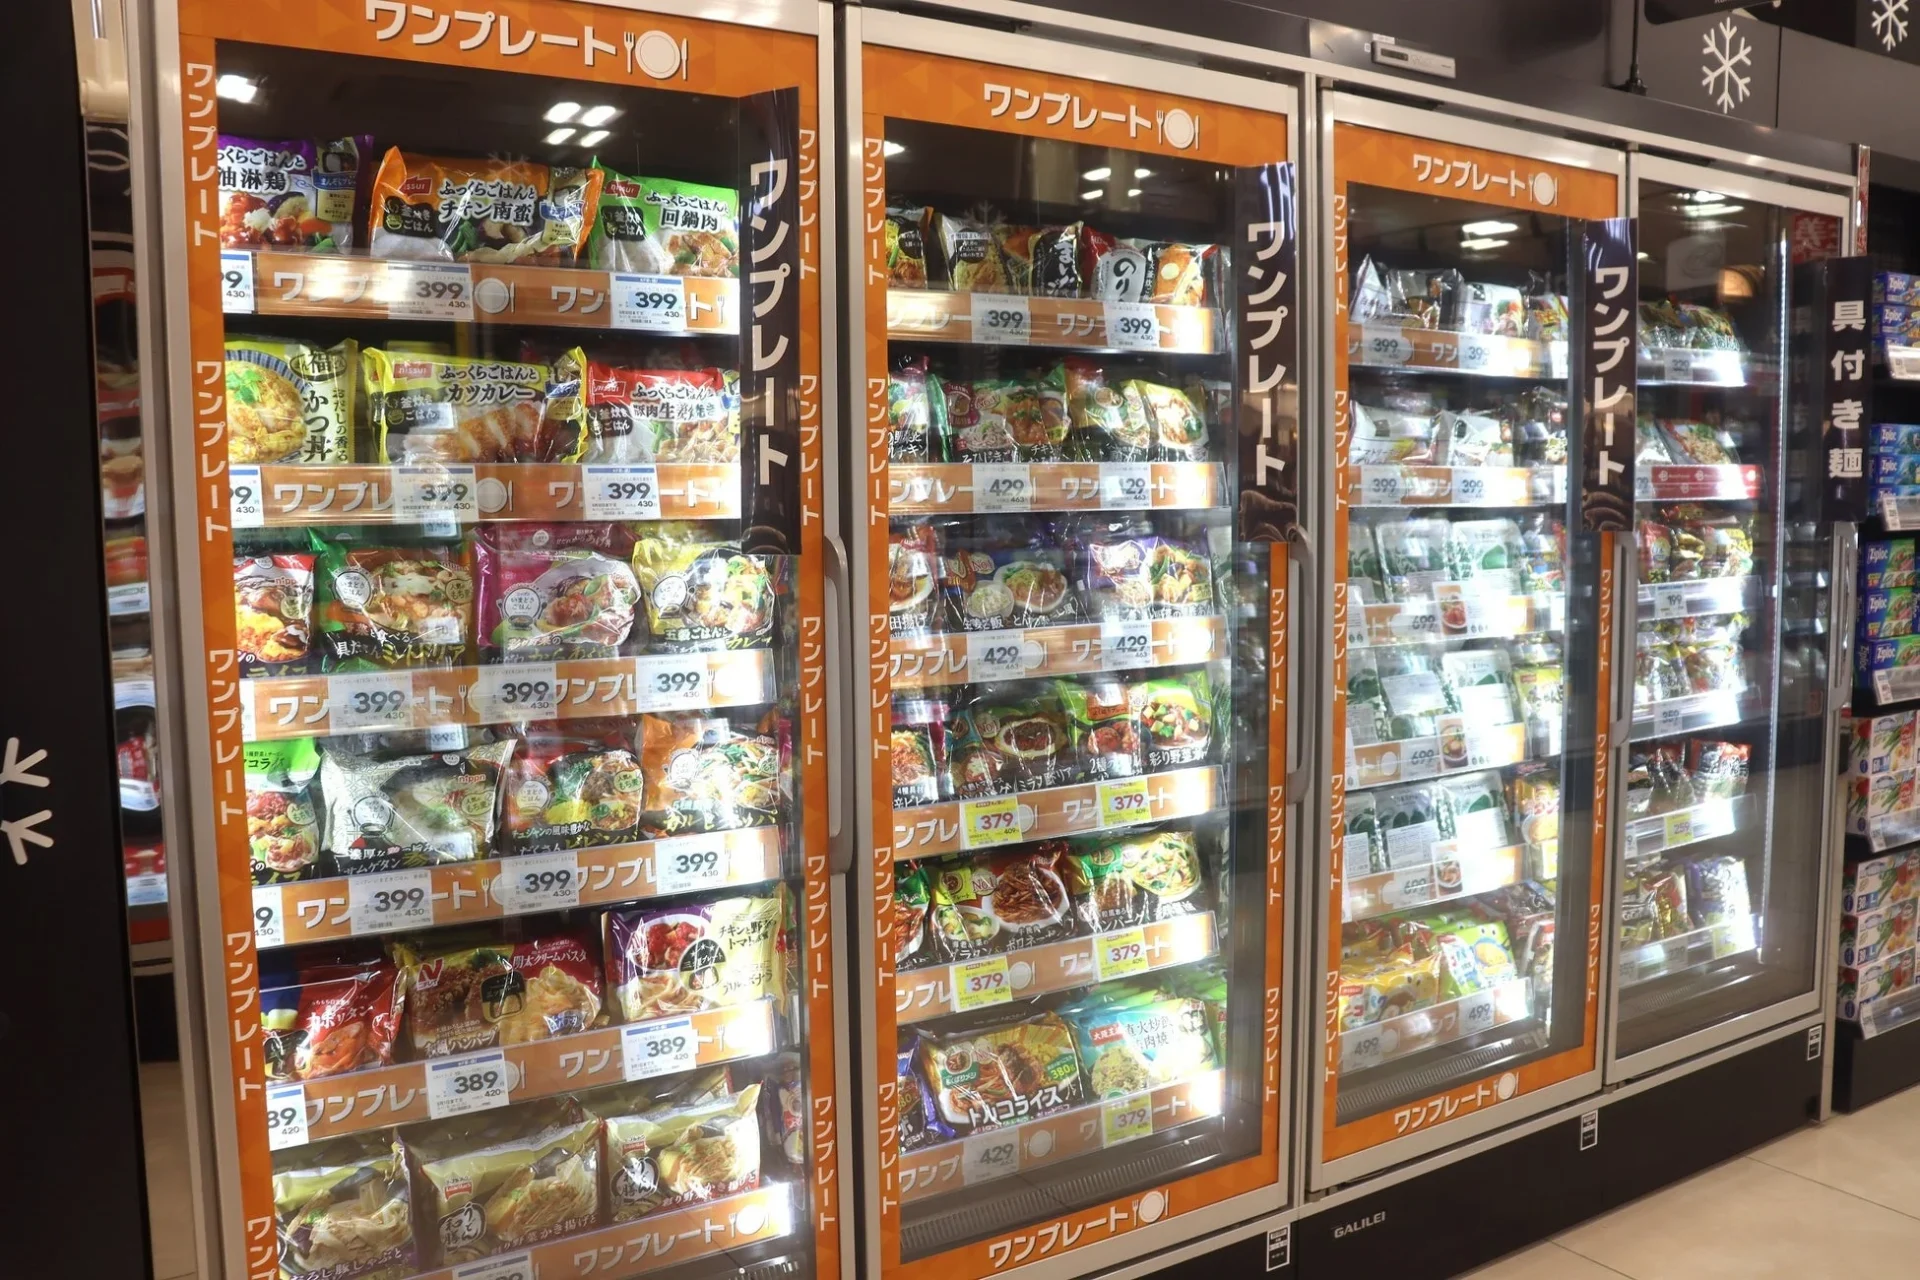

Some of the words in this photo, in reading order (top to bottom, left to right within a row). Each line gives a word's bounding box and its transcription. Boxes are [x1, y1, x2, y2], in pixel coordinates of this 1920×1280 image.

[366, 0, 617, 66] ワンプレート
[983, 82, 1152, 138] ワンプレート
[186, 63, 217, 246] ワンプレート
[1412, 153, 1526, 198] ワンプレート
[799, 129, 817, 279] ワンプレート
[864, 139, 884, 286] ワンプレート
[1334, 194, 1348, 315] ワンプレート
[415, 281, 464, 299] 399
[635, 291, 678, 309] 399
[448, 300, 467, 309] 430
[750, 159, 790, 486] ワンプレート
[988, 310, 1023, 328] 399
[1119, 317, 1152, 334] 399
[1247, 221, 1289, 486] ワンプレート
[1374, 338, 1399, 352] 399
[439, 364, 538, 381] ふっくらごはんと
[1593, 266, 1630, 486] ワンプレート
[448, 383, 536, 402] カツカレー
[1828, 300, 1866, 480] 具付き麺
[302, 390, 333, 463] かつ丼
[197, 361, 229, 541] ワンプレート
[800, 375, 819, 526] ワンプレート
[868, 377, 887, 526] ワンプレート
[1334, 391, 1348, 511] ワンプレート
[607, 483, 651, 500] 399
[989, 479, 1025, 497] 429
[1372, 478, 1398, 492] 399
[1462, 479, 1484, 492] 399
[236, 506, 255, 514] 430
[453, 502, 471, 510] 430
[1867, 546, 1889, 563] Ziploc
[1867, 596, 1889, 613] Ziploc
[1412, 615, 1436, 629] 699
[1600, 569, 1613, 673] ワンプレート
[1115, 635, 1147, 652] 429
[1272, 588, 1285, 712] ワンプレート
[1333, 583, 1347, 702] ワンプレート
[1876, 646, 1896, 661] Ziploc
[984, 646, 1019, 665] 429
[502, 681, 549, 704] 399
[657, 671, 700, 692] 399
[803, 616, 823, 765] ワンプレート
[870, 613, 889, 759] ワンプレート
[354, 690, 405, 714] 399
[209, 649, 243, 825] ワンプレート
[1411, 750, 1434, 764] 699
[1595, 734, 1607, 836] ワンプレート
[1114, 793, 1144, 811] 379
[980, 813, 1014, 831] 379
[1330, 774, 1343, 890] ワンプレート
[1270, 785, 1284, 905] ワンプレート
[676, 851, 719, 874] 399
[702, 869, 719, 877] 430
[524, 869, 571, 894] 399
[552, 889, 571, 897] 430
[1404, 878, 1427, 894] 699
[374, 888, 425, 914] 399
[404, 908, 425, 916] 430
[253, 906, 273, 928] 9
[808, 855, 828, 998] ワンプレート
[874, 846, 894, 987] ワンプレート
[1111, 944, 1141, 963] 379
[1588, 903, 1600, 1002] ワンプレート
[970, 973, 1004, 993] 379
[227, 931, 261, 1100] ワンプレート
[1469, 1003, 1490, 1019] 499
[1325, 970, 1339, 1082] ワンプレート
[646, 1036, 686, 1058] 389
[1266, 987, 1279, 1103] ワンプレート
[1354, 1037, 1379, 1056] 499
[453, 1071, 499, 1094] 389
[484, 1089, 501, 1097] 420
[307, 1084, 427, 1127] ワンプレ
[1394, 1083, 1491, 1134] ワンプレート
[1117, 1108, 1147, 1127] 379
[281, 1127, 300, 1135] 420
[878, 1081, 897, 1215] ワンプレート
[980, 1144, 1014, 1164] 429
[815, 1096, 835, 1231] ワンプレート
[1334, 1211, 1386, 1238] GALILEI
[574, 1217, 725, 1277] ワンプレート
[988, 1206, 1130, 1269] ワンプレート
